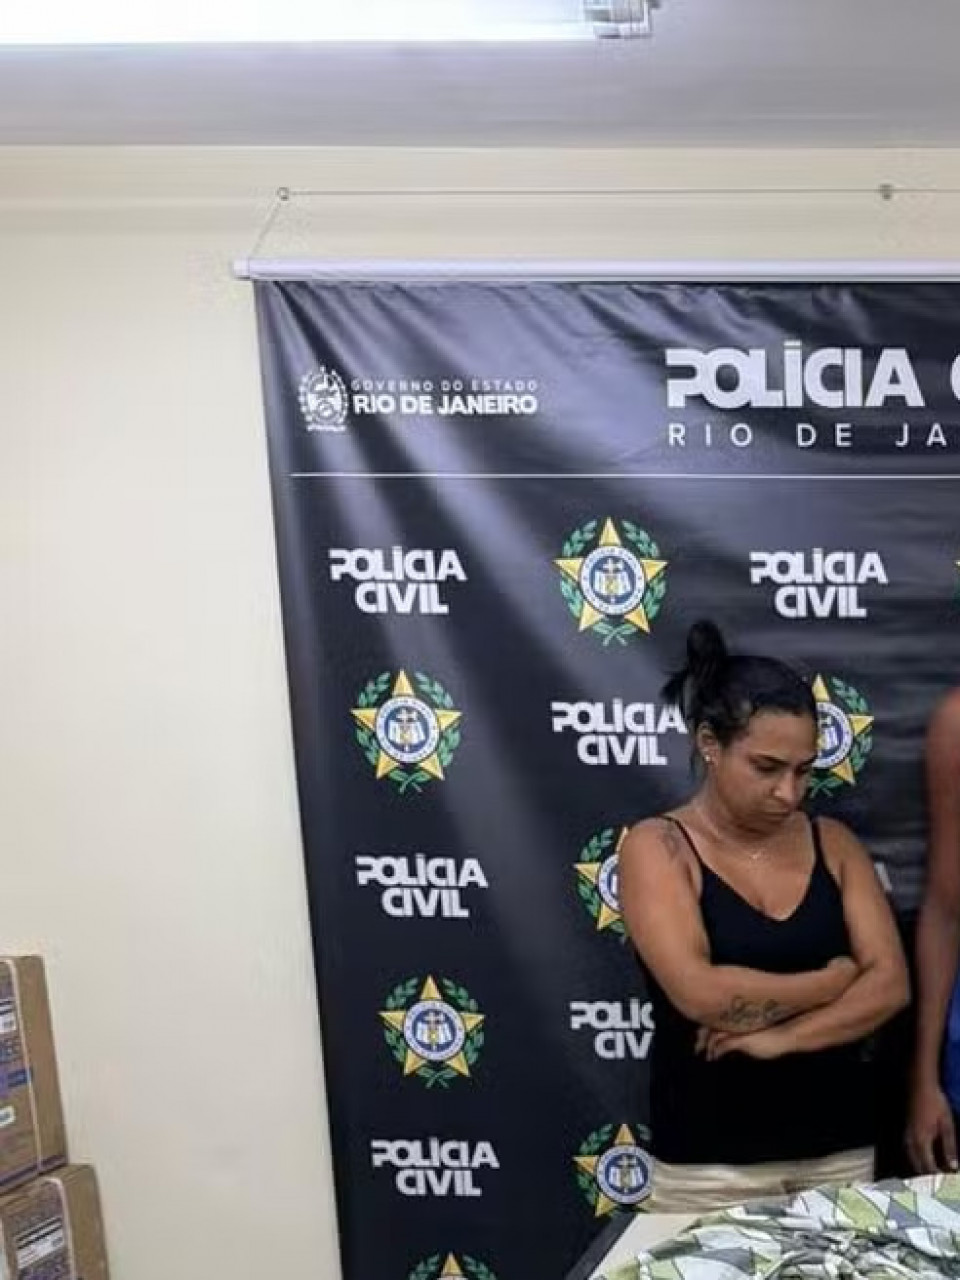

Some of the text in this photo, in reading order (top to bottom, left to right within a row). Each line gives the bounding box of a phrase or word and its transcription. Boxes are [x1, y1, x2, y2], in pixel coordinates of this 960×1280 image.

[351, 379, 538, 392] GOVERNO DO ESTADO
[665, 340, 925, 408] POLÍCIA
[353, 394, 538, 415] RIO DE JANEIRO
[668, 422, 753, 448] RIO
[797, 422, 853, 448] DE
[329, 546, 467, 581] POLÍCIA
[750, 548, 888, 584] POLÍCIA
[355, 581, 448, 615] CIVIL
[774, 583, 867, 618] CIVIL
[551, 698, 688, 734] POLÍCIA
[577, 735, 668, 765] CIVIL
[355, 852, 488, 888] POLÍCIA
[382, 887, 469, 918] CIVIL
[570, 998, 655, 1030] POLÍC
[595, 1031, 654, 1058] CIV
[371, 1136, 499, 1169] POLÍCIA
[395, 1166, 482, 1197] CIVIL
